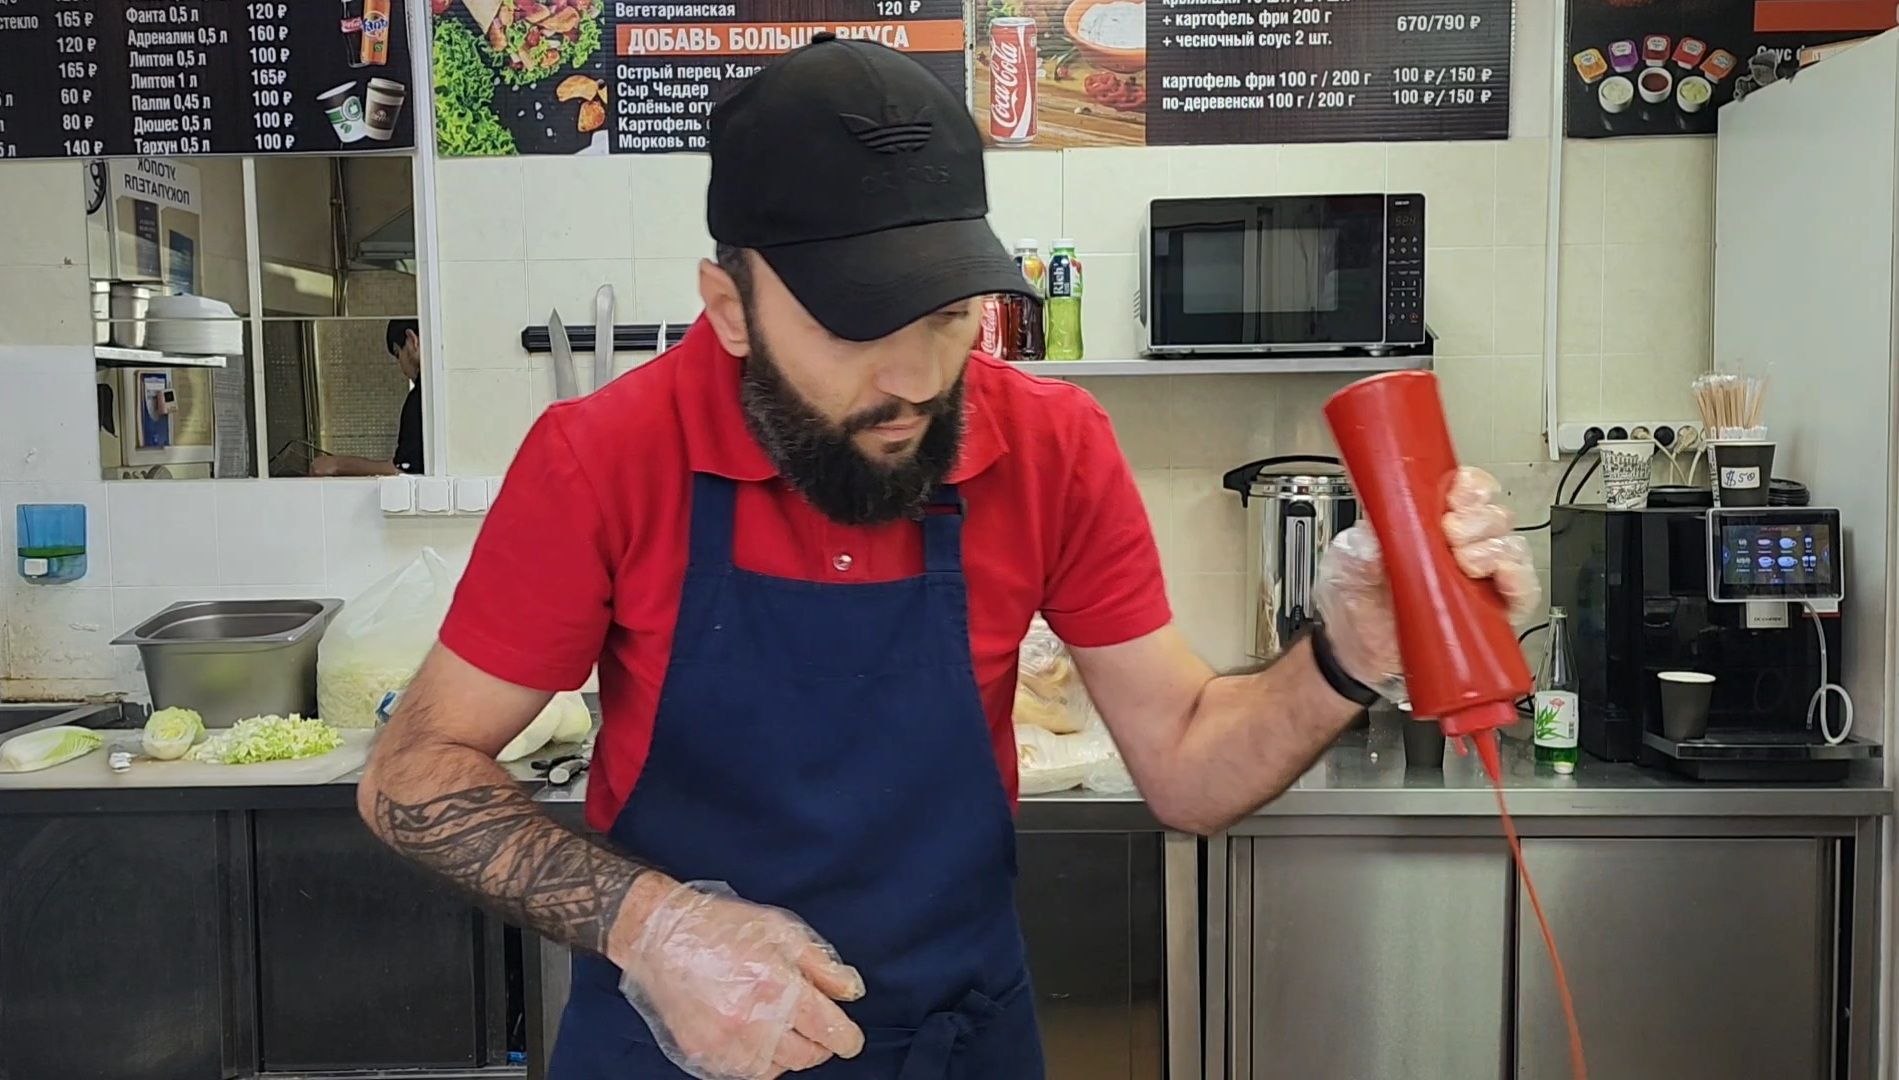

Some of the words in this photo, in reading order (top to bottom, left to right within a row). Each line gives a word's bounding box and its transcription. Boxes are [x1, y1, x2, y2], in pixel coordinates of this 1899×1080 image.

[126, 6, 166, 23] Фанта
[169, 6, 188, 24] 0,5
[190, 8, 199, 22] л
[247, 3, 274, 20] 120
[278, 4, 288, 19] ₽
[615, 2, 736, 20] Вегетарианская
[876, 1, 902, 16] 120
[909, 0, 921, 14] ₽
[54, 11, 80, 28] 165
[84, 12, 94, 26] ₽
[1175, 10, 1254, 29] картофель
[1259, 10, 1289, 28] фри
[1292, 9, 1320, 24] 200
[1324, 12, 1332, 24] г
[1397, 14, 1465, 32] 670/790
[1470, 16, 1480, 30] ₽
[128, 29, 195, 48] Адреналин
[198, 27, 216, 46] 0,5
[220, 30, 228, 44] л
[248, 25, 274, 42] 160
[278, 26, 288, 41] ₽
[628, 28, 721, 55] ДОБАВЬ
[1175, 31, 1254, 48] чесночный
[1258, 33, 1291, 49] соус
[1295, 30, 1304, 45] 2
[1308, 32, 1332, 45] шт.
[56, 36, 83, 52] 120
[87, 38, 96, 52] ₽
[129, 50, 174, 68] Липтон
[176, 50, 194, 68] 0,5
[198, 52, 206, 66] л
[250, 47, 276, 64] 100
[280, 48, 290, 63] ₽
[58, 62, 84, 78] 165
[88, 63, 98, 78] ₽
[616, 64, 673, 82] Острый
[678, 66, 722, 81] перец
[1393, 68, 1419, 82] 100
[1450, 66, 1476, 82] 150
[1481, 68, 1492, 82] ₽
[131, 74, 175, 90] Липтон
[178, 72, 184, 88] 1
[190, 74, 198, 88] л
[1162, 72, 1242, 91] картофель
[1245, 72, 1275, 90] фри
[1279, 72, 1306, 87] 100
[1310, 74, 1318, 86] г
[1321, 70, 1328, 88] /
[1332, 70, 1360, 86] 200
[1364, 73, 1372, 85] г
[61, 88, 78, 104] 60
[83, 89, 92, 104] ₽
[252, 90, 279, 106] 100
[282, 92, 292, 106] ₽
[617, 82, 648, 99] Сыр
[653, 82, 708, 99] Чеддер
[1393, 90, 1418, 104] 100
[1448, 89, 1474, 104] 150
[1480, 90, 1492, 104] ₽
[132, 94, 170, 111] Палпи
[174, 94, 200, 112] 0,45
[202, 96, 210, 109] л
[618, 99, 684, 114] Солёные
[688, 102, 716, 116] огу
[1162, 95, 1264, 112] по-деревенски
[1268, 92, 1294, 108] 100
[1298, 96, 1304, 108] г
[1308, 92, 1314, 108] /
[1318, 92, 1344, 108] 200
[1348, 94, 1356, 106] г
[63, 114, 80, 130] 80
[84, 115, 94, 130] ₽
[134, 116, 178, 135] Дюшес
[182, 115, 200, 133] 0,5
[203, 117, 211, 130] л
[254, 112, 280, 128] 100
[284, 113, 294, 128] ₽
[618, 117, 702, 134] Картофель
[64, 140, 90, 156] 140
[94, 141, 104, 155] ₽
[134, 138, 178, 155] Тархун
[180, 137, 198, 154] 0,5
[202, 139, 210, 152] л
[255, 134, 282, 150] 100
[285, 134, 295, 150] ₽
[618, 134, 684, 150] Морковь
